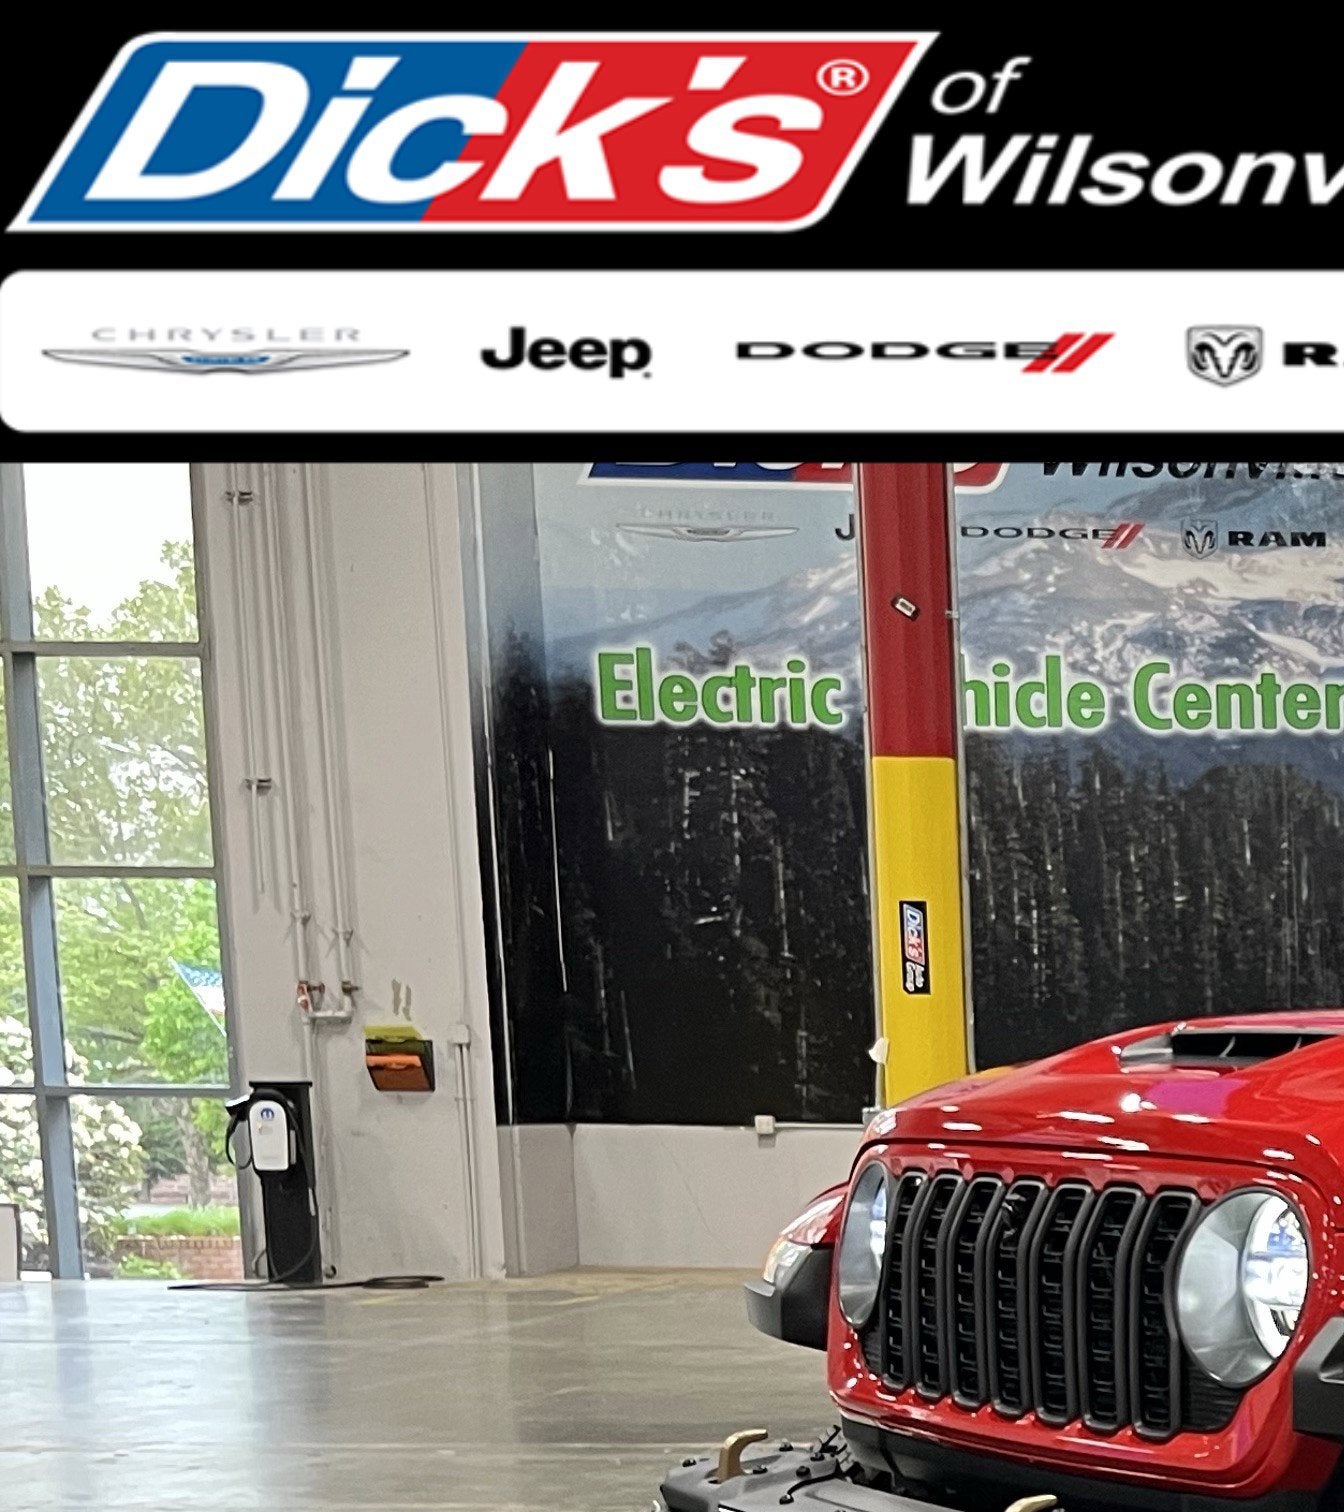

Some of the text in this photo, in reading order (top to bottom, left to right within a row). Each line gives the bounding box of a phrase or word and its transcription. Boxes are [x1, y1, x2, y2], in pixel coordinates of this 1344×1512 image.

[960, 525, 1112, 542] DODGE
[1227, 530, 1326, 548] RAM
[597, 646, 843, 725] Electric
[961, 653, 1106, 729] hicle
